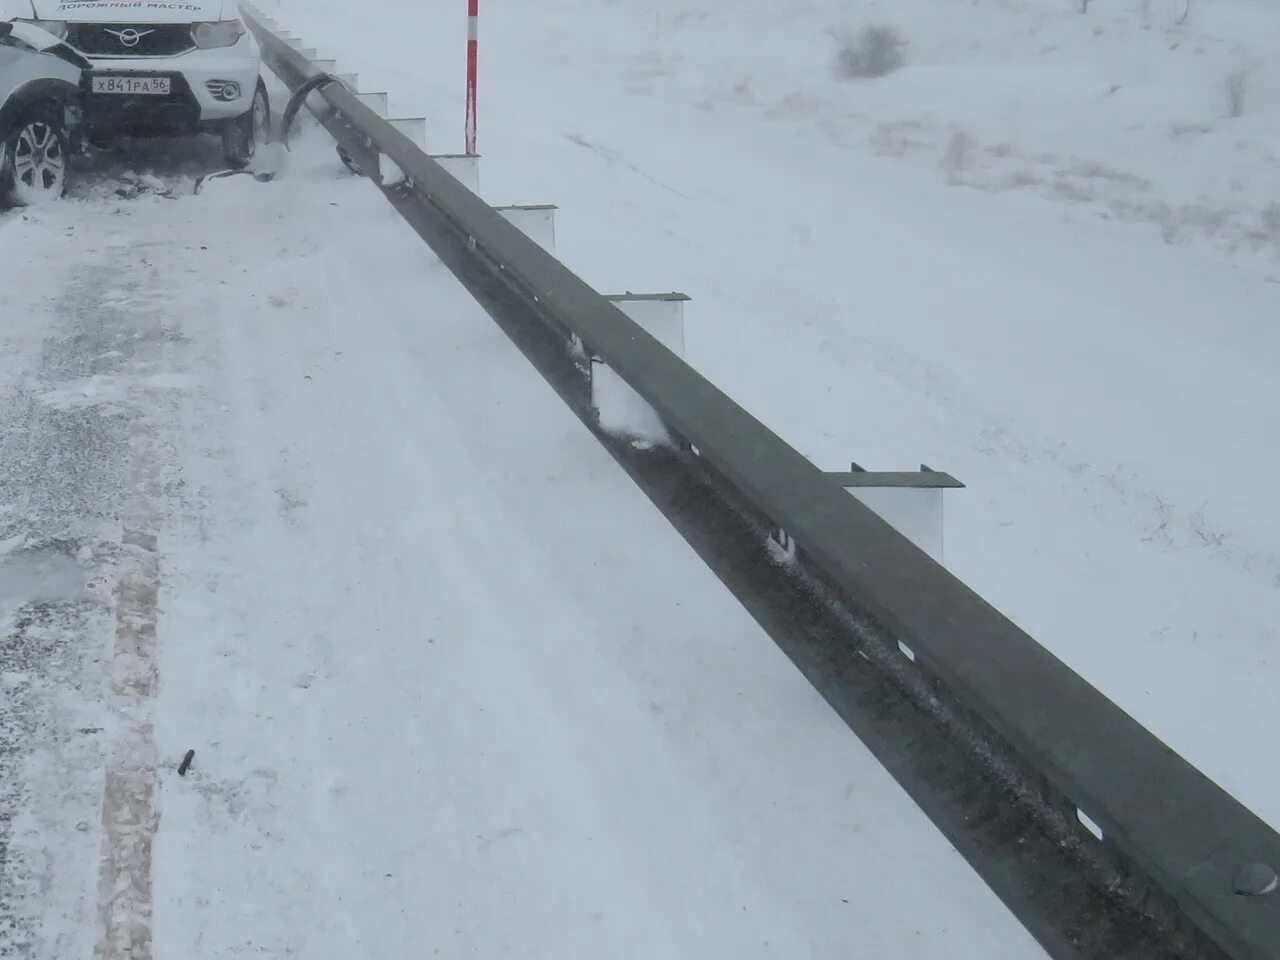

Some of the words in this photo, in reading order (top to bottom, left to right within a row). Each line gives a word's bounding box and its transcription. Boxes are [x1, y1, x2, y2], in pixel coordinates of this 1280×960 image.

[56, 2, 142, 11] ДОРОЖНЫЙ
[147, 3, 202, 11] МАСТЕР
[97, 78, 149, 92] Х841РА
